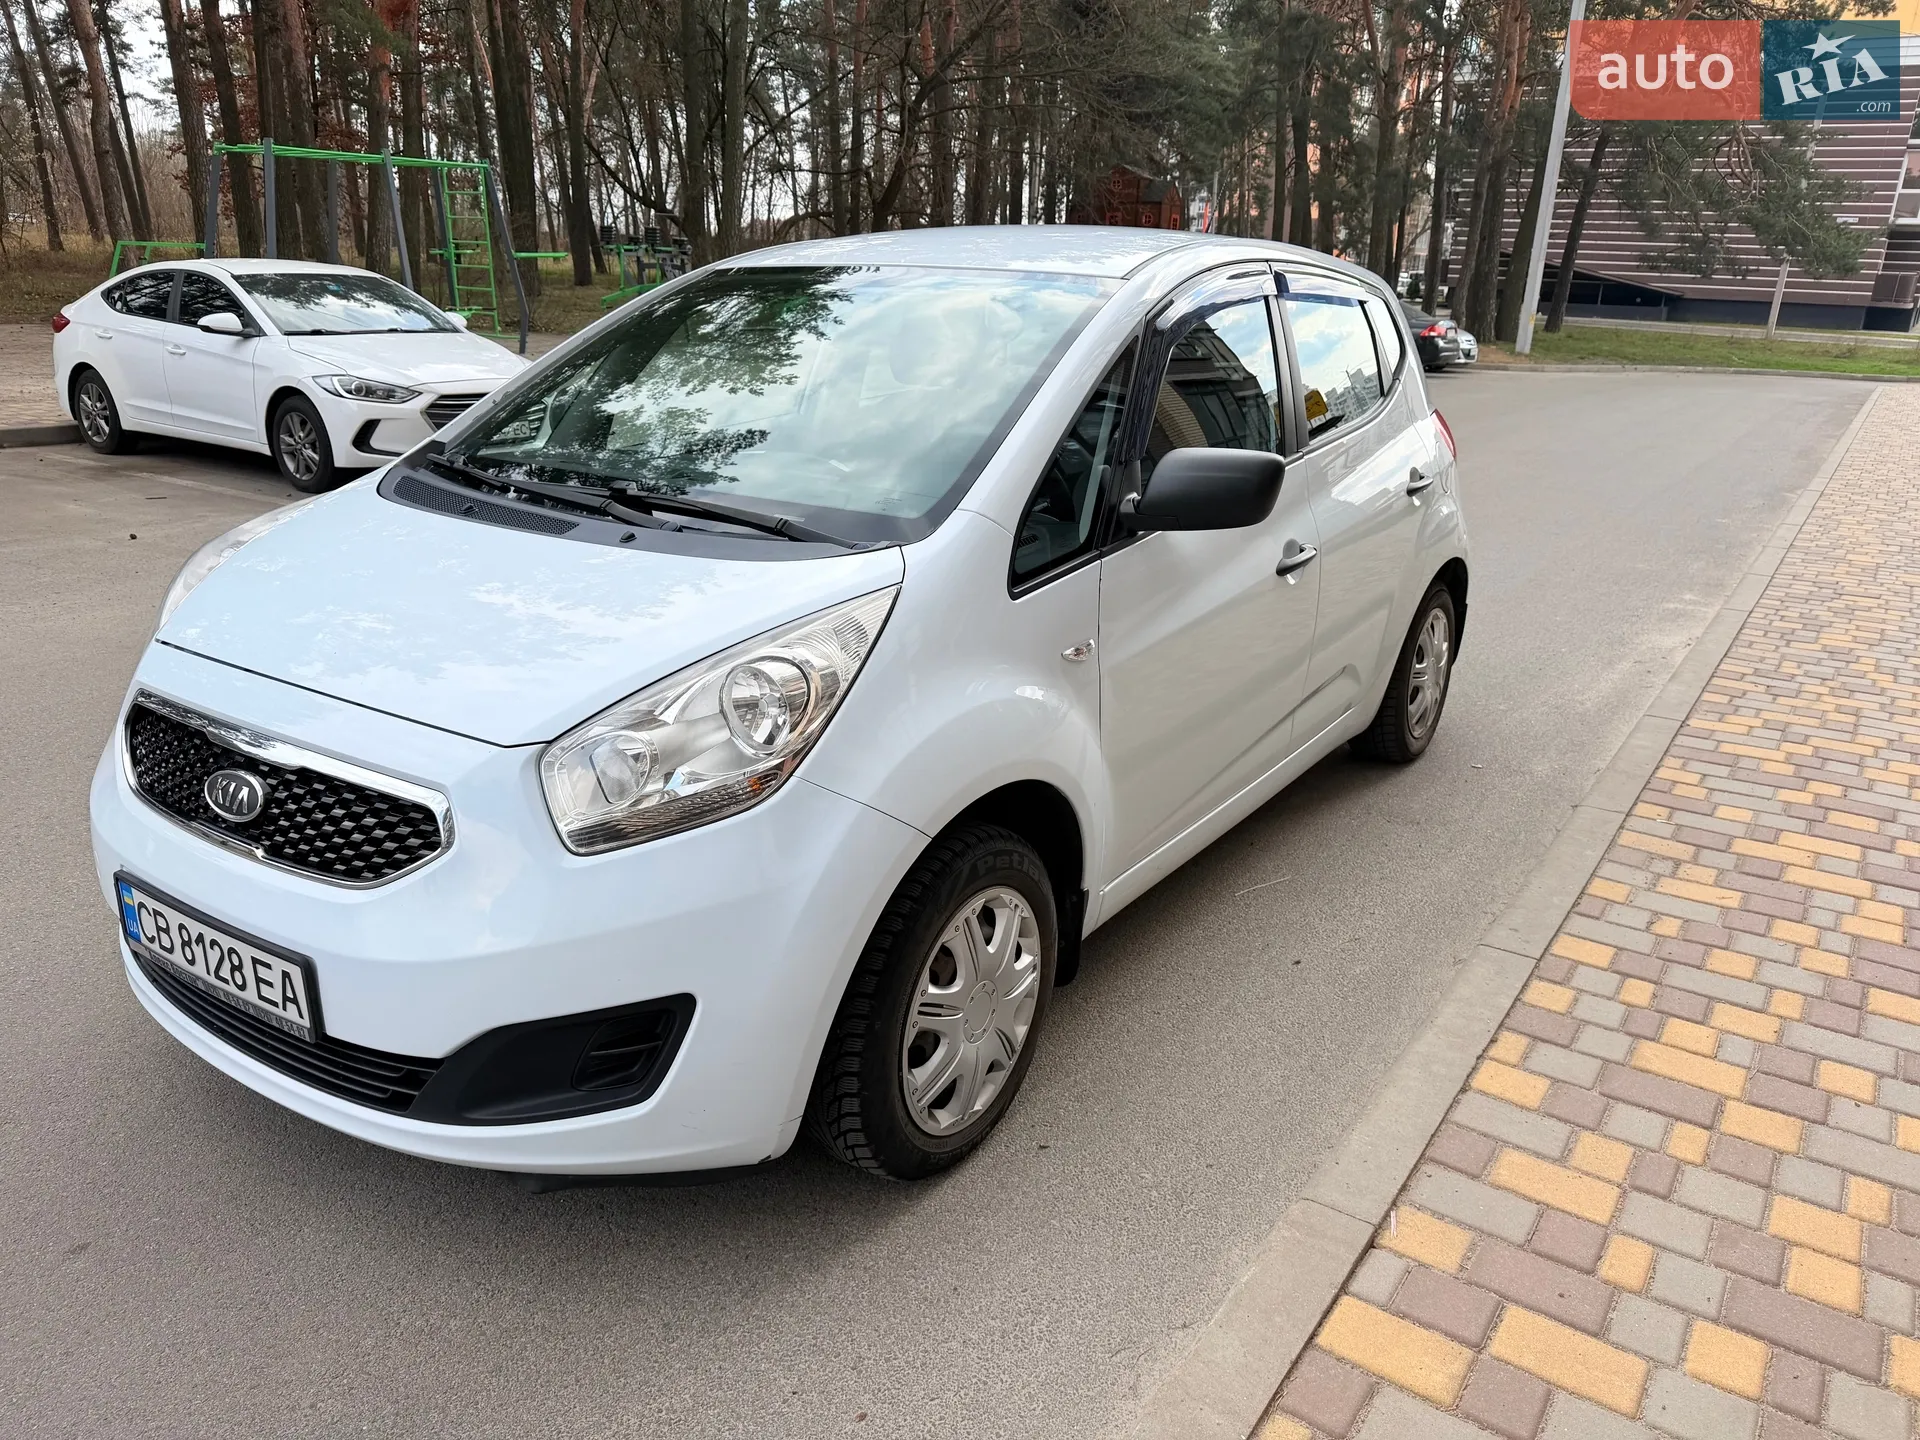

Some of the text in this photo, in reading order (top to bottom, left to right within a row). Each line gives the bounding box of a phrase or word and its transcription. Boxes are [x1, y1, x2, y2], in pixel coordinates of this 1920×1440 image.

[211, 776, 249, 814] KIA
[128, 918, 140, 936] UA
[137, 901, 175, 955] CB
[178, 922, 247, 992] 8128
[250, 955, 304, 1020] EA
